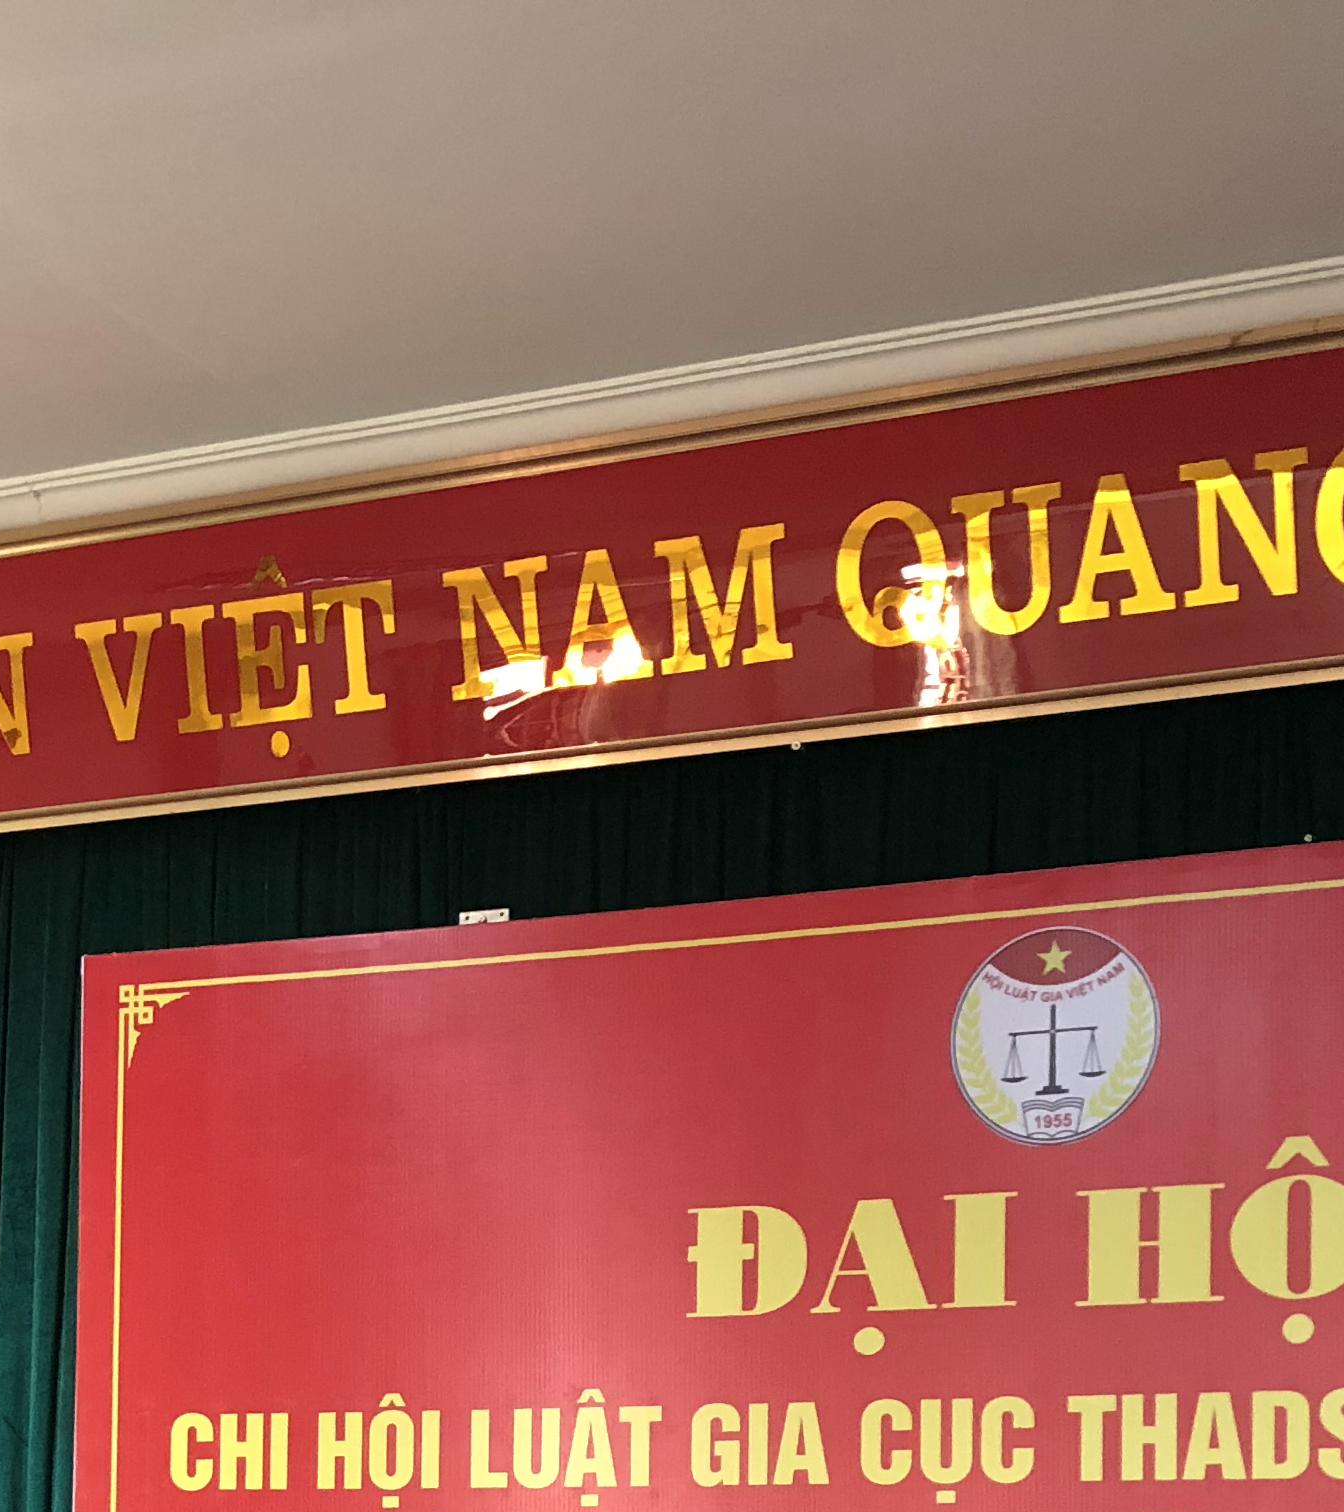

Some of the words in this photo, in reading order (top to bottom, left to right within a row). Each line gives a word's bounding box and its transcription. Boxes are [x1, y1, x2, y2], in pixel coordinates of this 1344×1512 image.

[74, 557, 398, 760] VIỆT
[452, 523, 793, 702] NAM
[982, 971, 1002, 990] HỘI
[1004, 984, 1036, 1003] LUẬT
[1040, 991, 1063, 1002] GIA
[1065, 981, 1095, 999] VIỆT
[1096, 962, 1126, 986] NAM
[1034, 1113, 1073, 1129] 1955
[688, 1192, 1016, 1356] ĐẠI
[170, 1413, 288, 1491] CHI
[318, 1394, 440, 1509] HỘI
[470, 1388, 663, 1508] LUẬT
[691, 1402, 829, 1488] GIA
[860, 1396, 1035, 1504] CỤC
